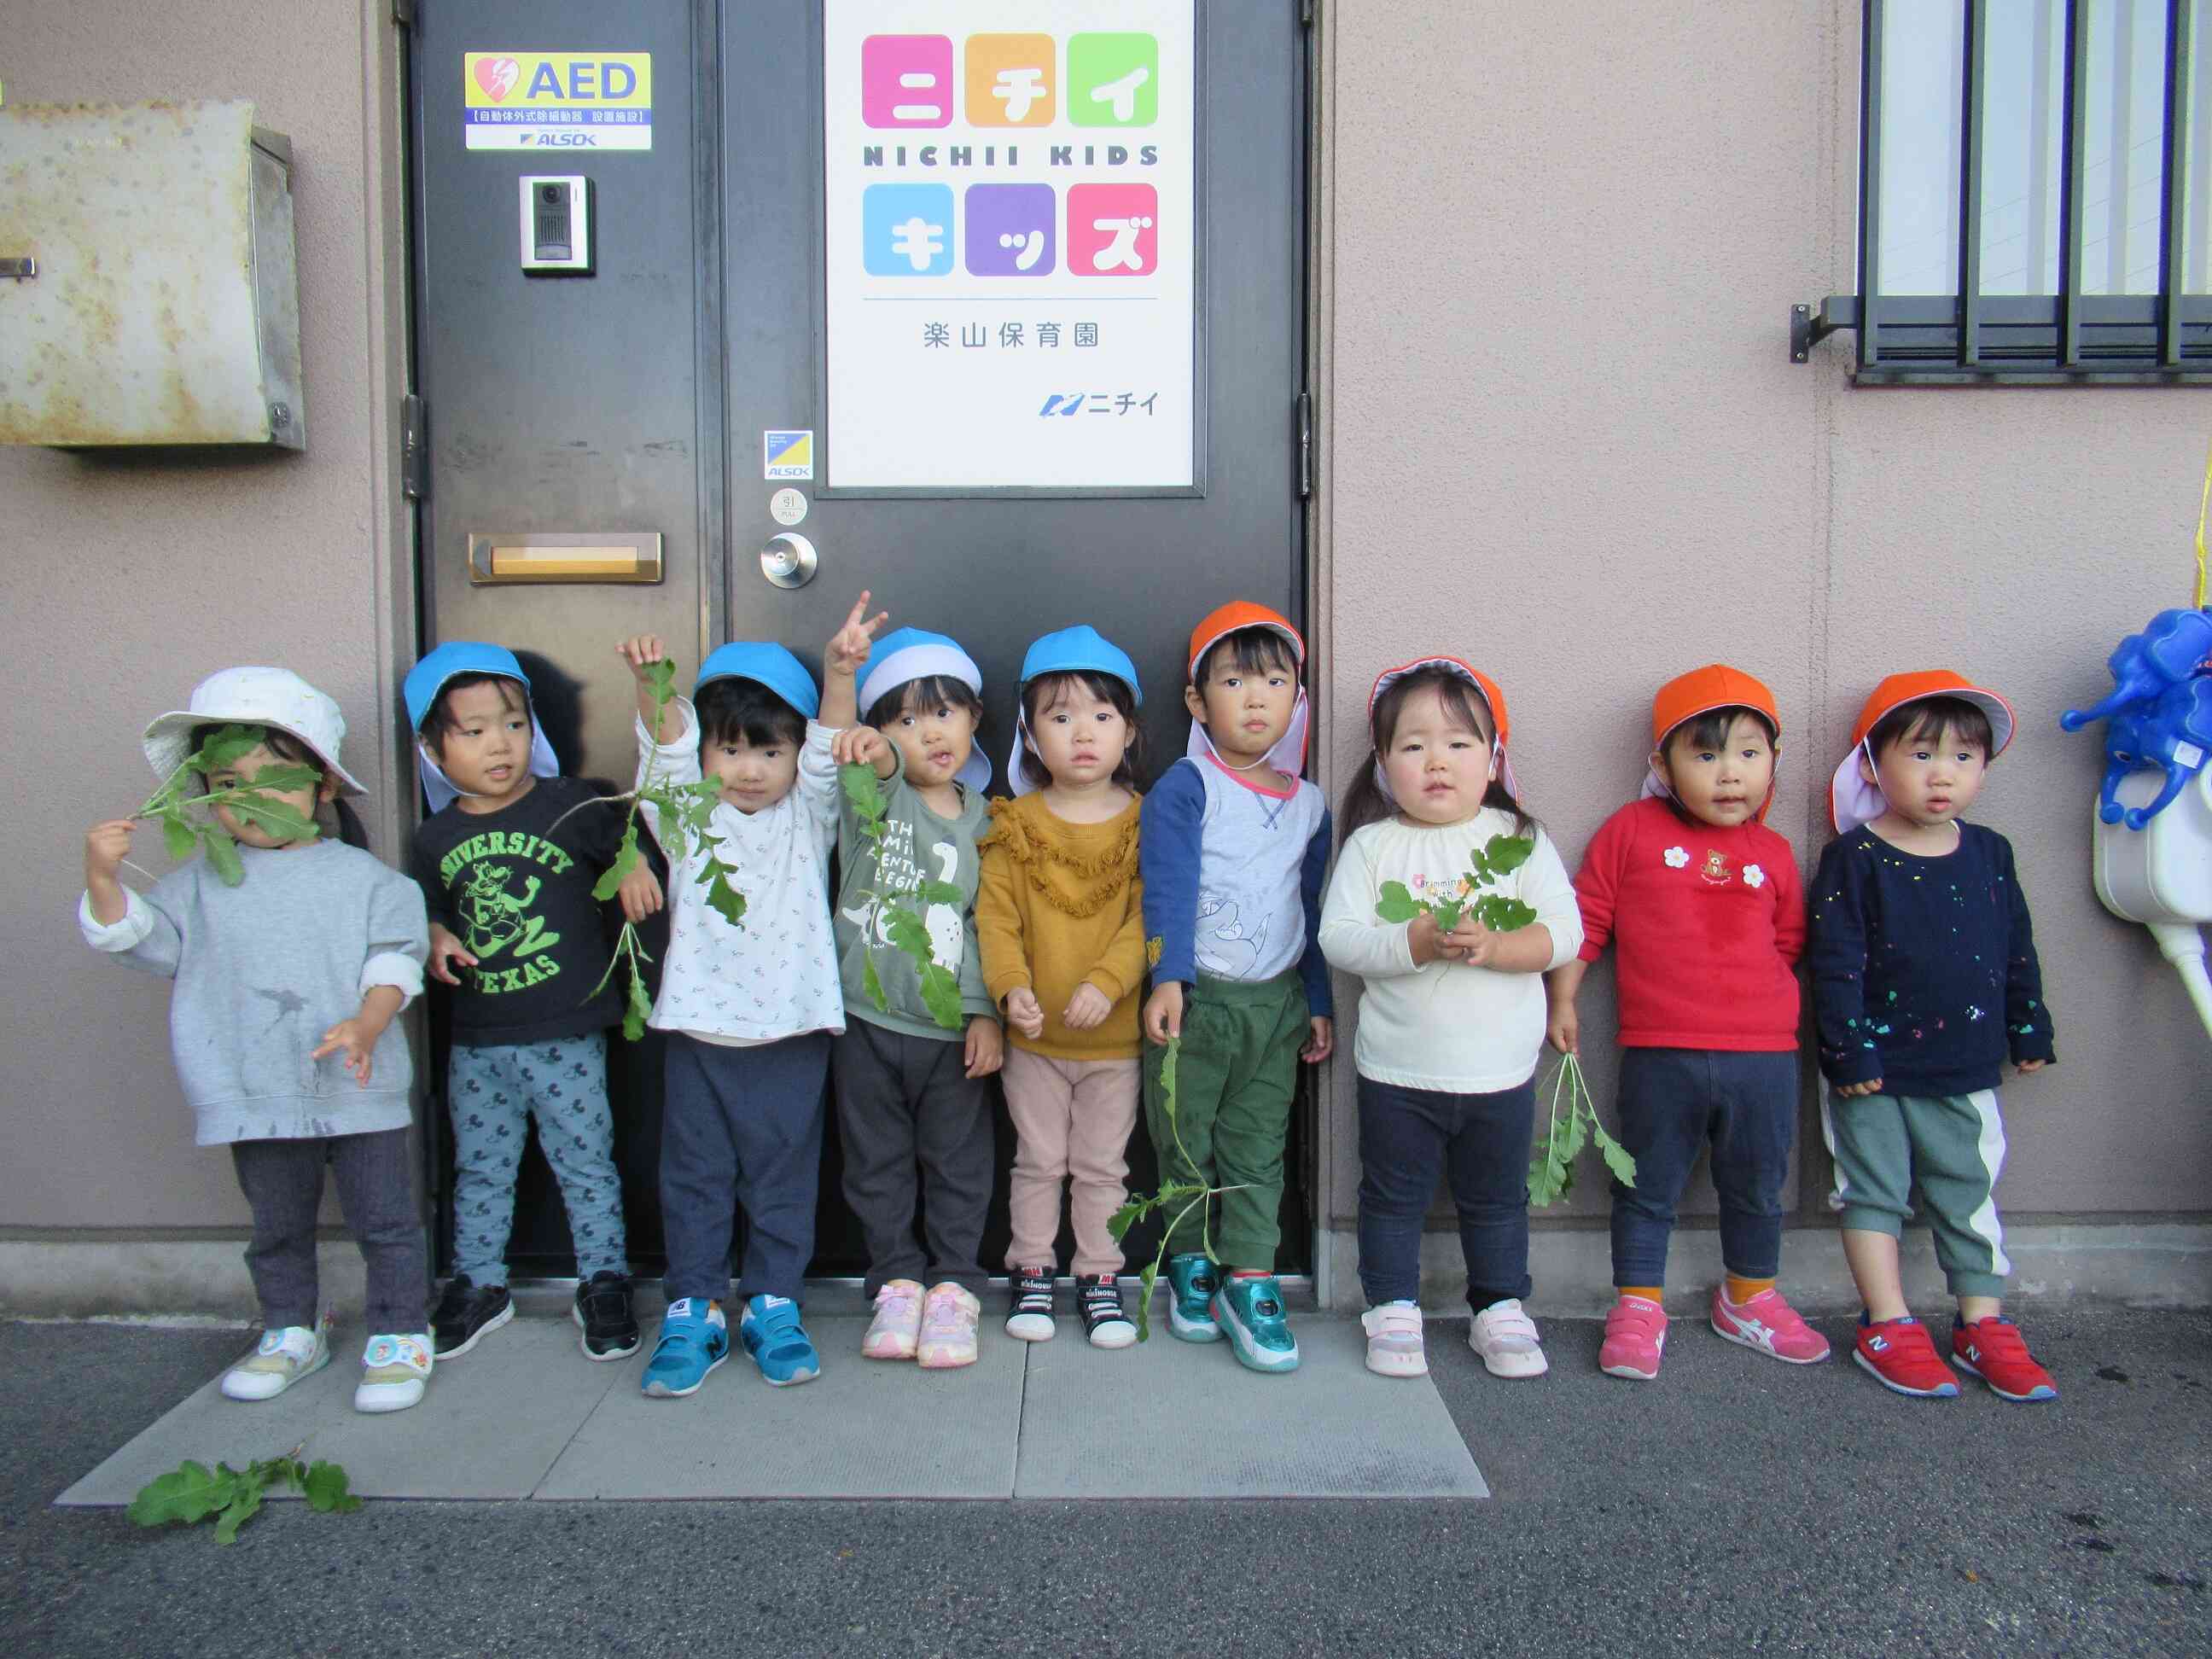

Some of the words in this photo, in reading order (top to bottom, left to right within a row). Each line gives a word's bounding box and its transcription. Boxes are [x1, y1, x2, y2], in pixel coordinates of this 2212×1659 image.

[526, 61, 637, 100] AED
[537, 133, 597, 147] ALSOK
[864, 146, 1019, 166] NICHII
[1050, 145, 1159, 166] KIDS
[923, 321, 1099, 349] 楽山保育園
[1087, 391, 1160, 416] ニチイ
[768, 467, 810, 477] ALSOK
